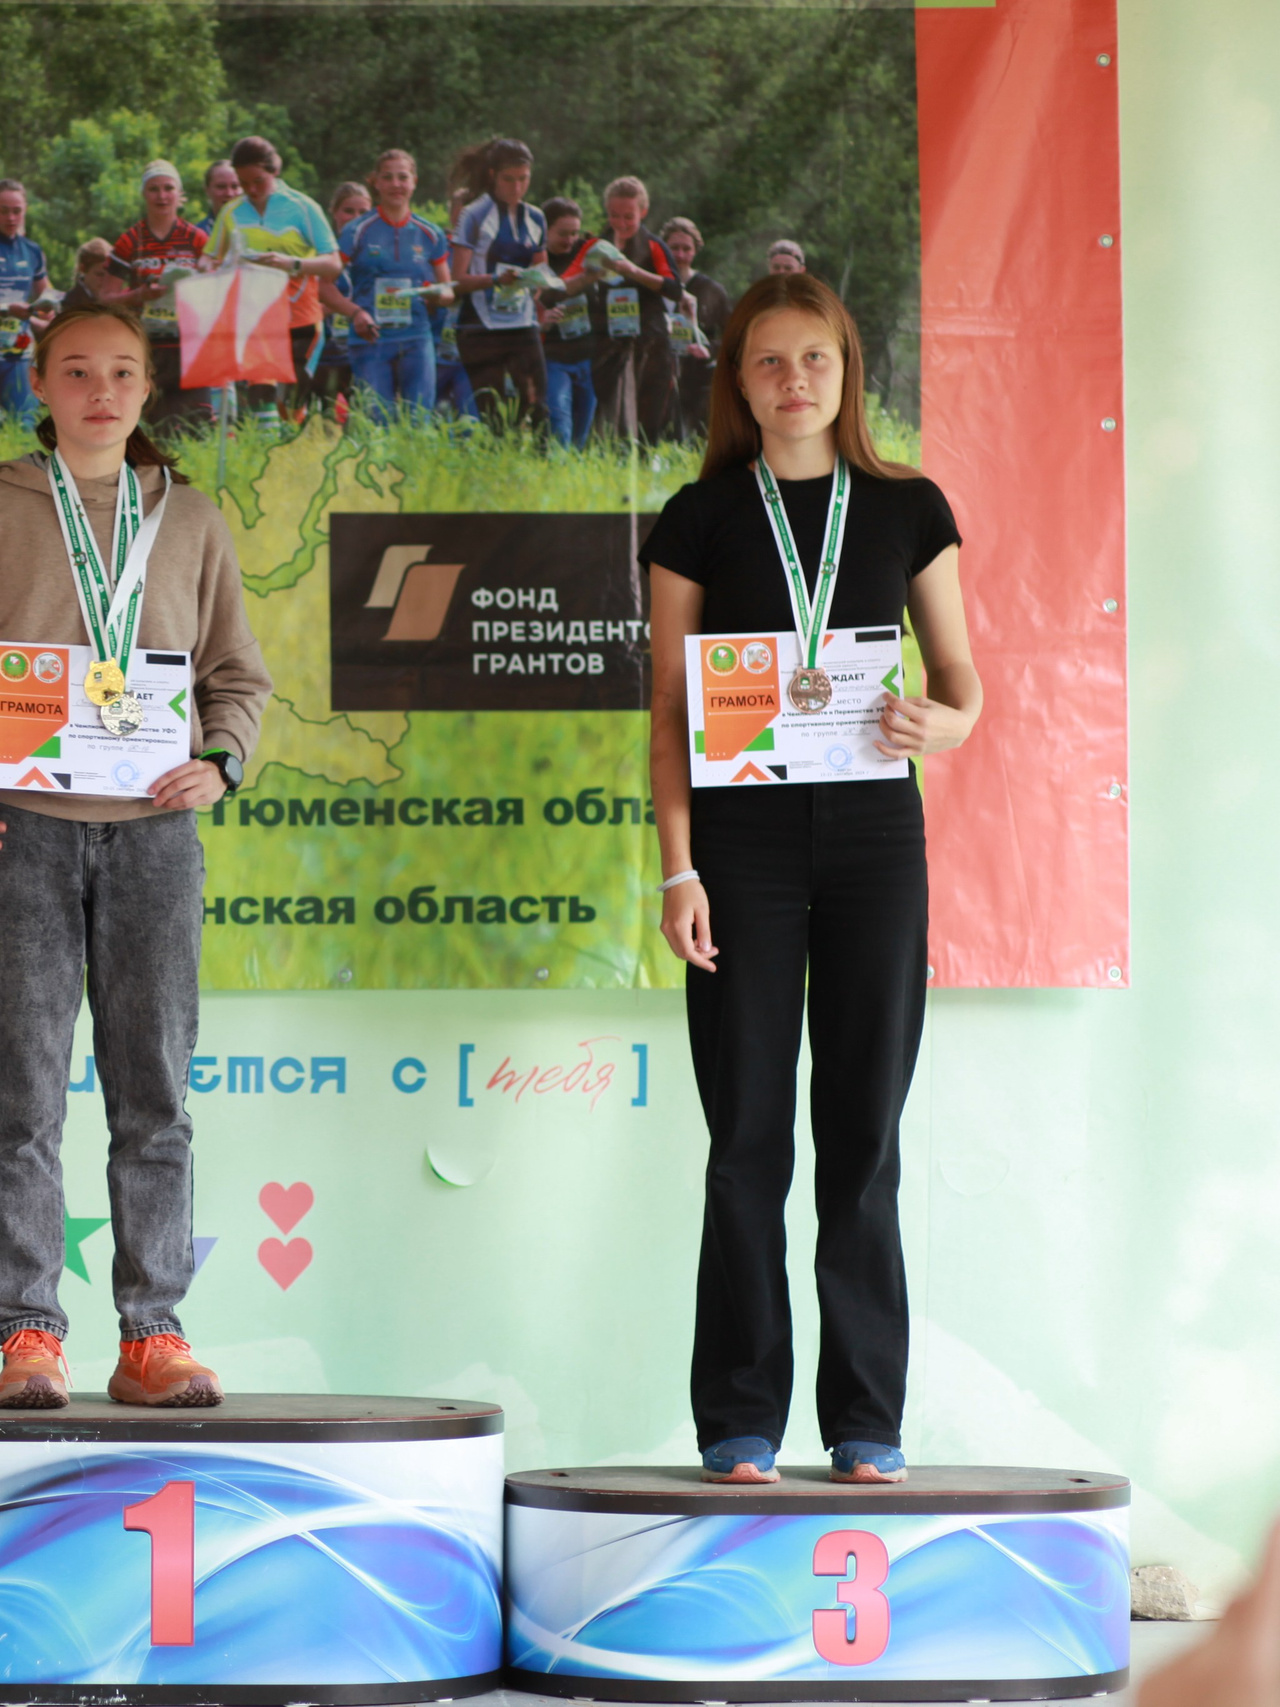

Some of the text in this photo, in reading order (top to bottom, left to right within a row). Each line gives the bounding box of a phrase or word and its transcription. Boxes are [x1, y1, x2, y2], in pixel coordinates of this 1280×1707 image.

[471, 587, 559, 612] ФОНД
[473, 653, 605, 675] ГРАНТОВ
[0, 700, 63, 715] ГРАМОТА
[710, 694, 775, 708] ГРАМОТА
[374, 886, 596, 925] область
[392, 1057, 427, 1094] с
[124, 1480, 195, 1647] 1
[812, 1529, 890, 1666] 3
